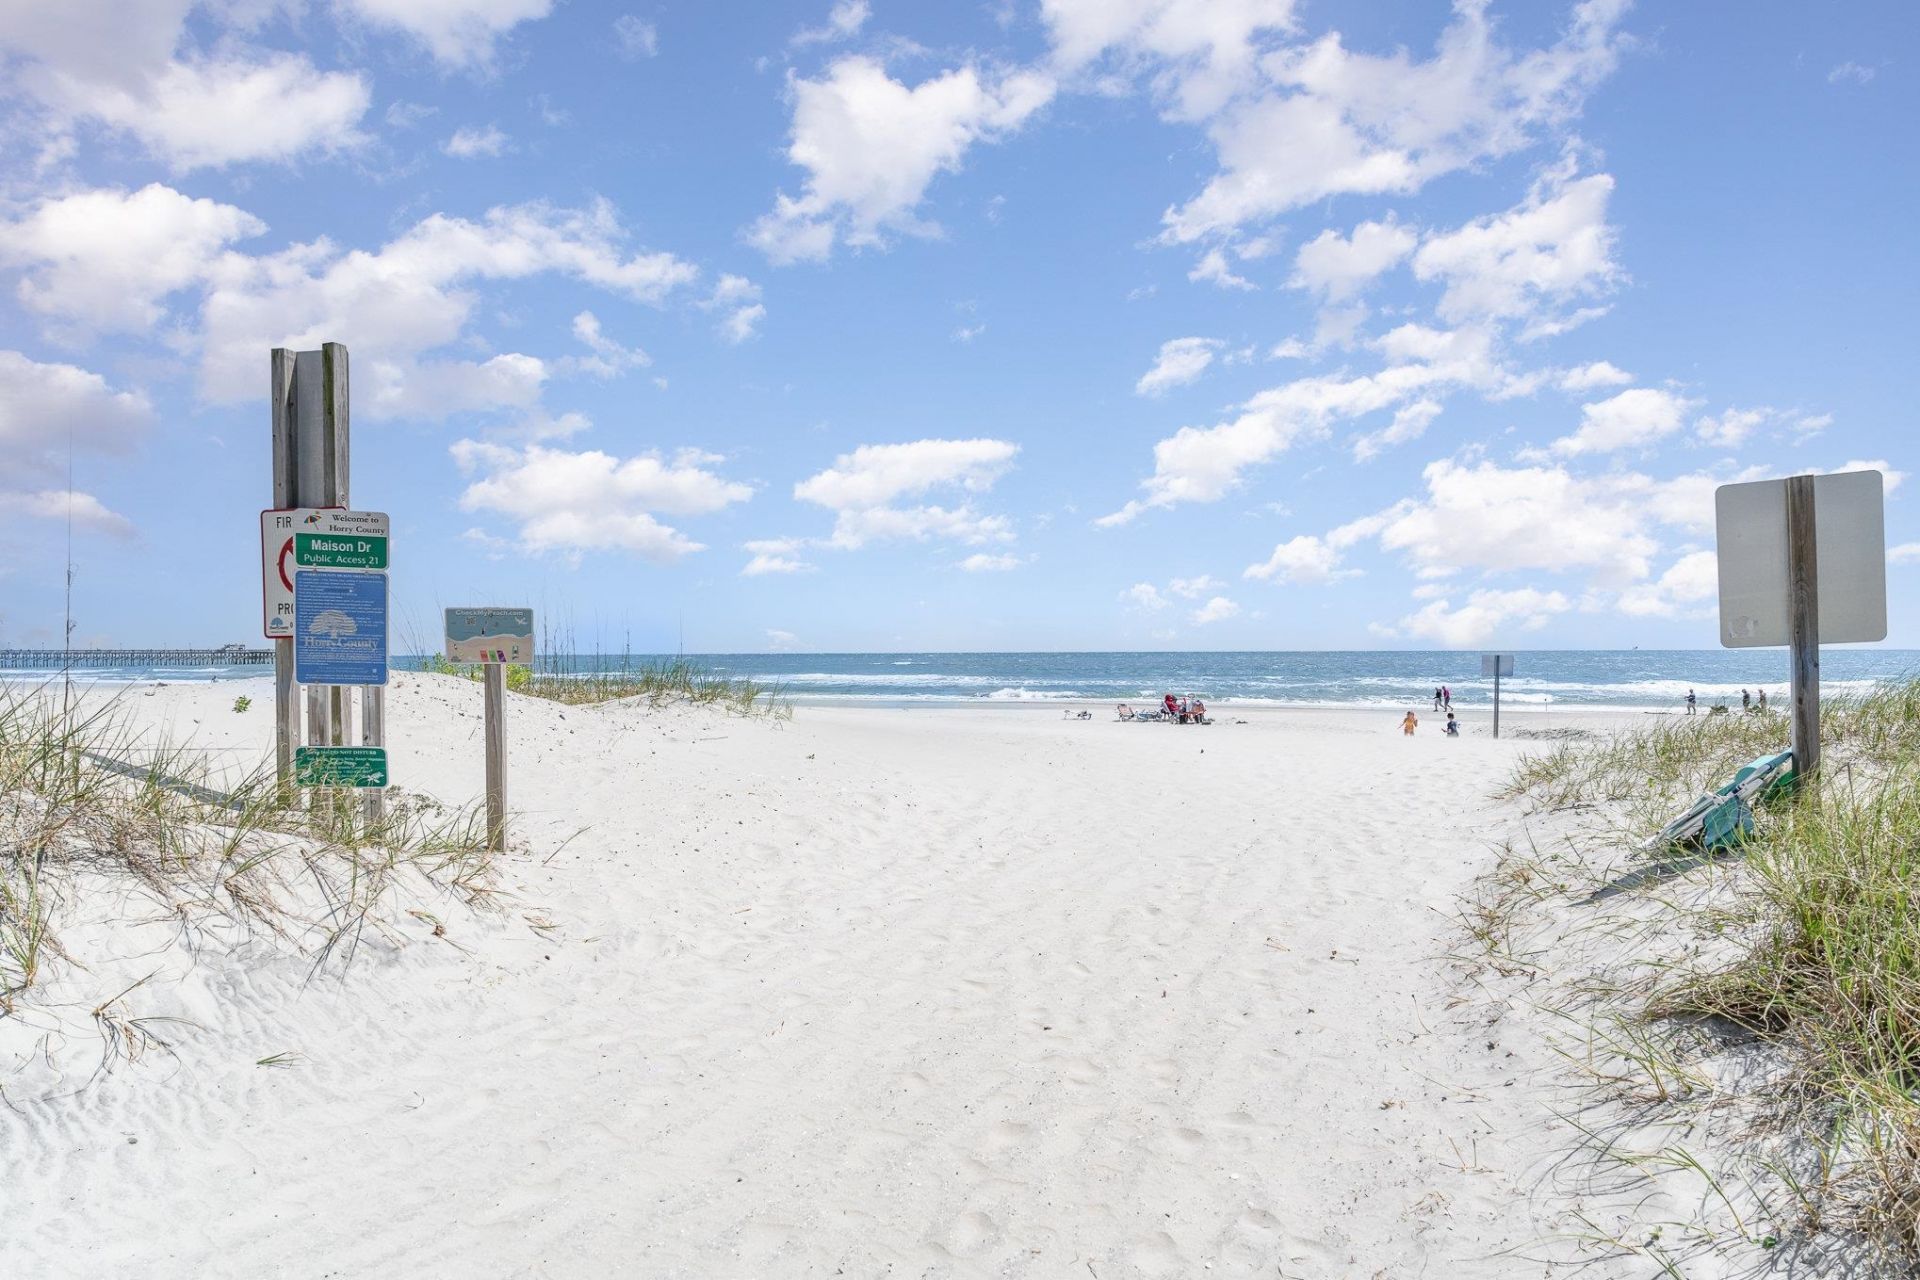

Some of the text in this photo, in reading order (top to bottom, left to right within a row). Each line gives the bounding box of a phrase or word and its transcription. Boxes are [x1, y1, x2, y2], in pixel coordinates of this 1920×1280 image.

[332, 514, 369, 523] Welcome
[329, 524, 386, 536] Horry County
[311, 539, 372, 552] Maison Dr
[304, 554, 378, 565] Public Access 21
